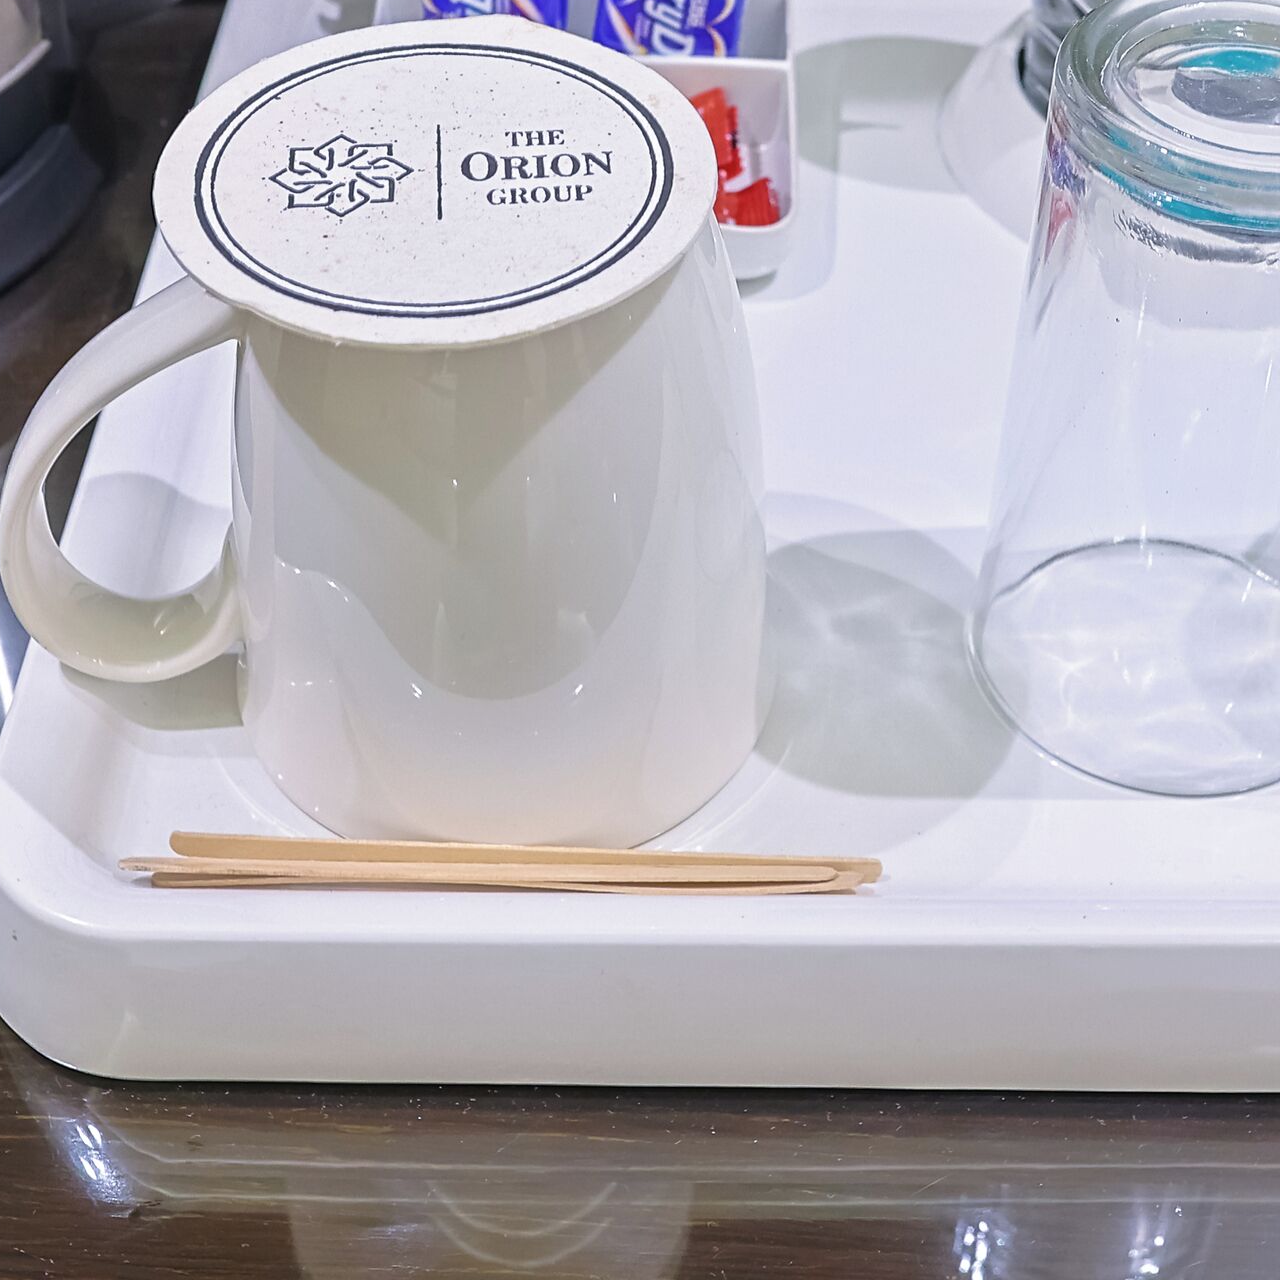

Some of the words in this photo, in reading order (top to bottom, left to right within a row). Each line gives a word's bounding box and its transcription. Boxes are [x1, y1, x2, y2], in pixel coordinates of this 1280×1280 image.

[504, 129, 566, 147] THE
[460, 150, 614, 182] ORION
[486, 184, 594, 206] GROUP
